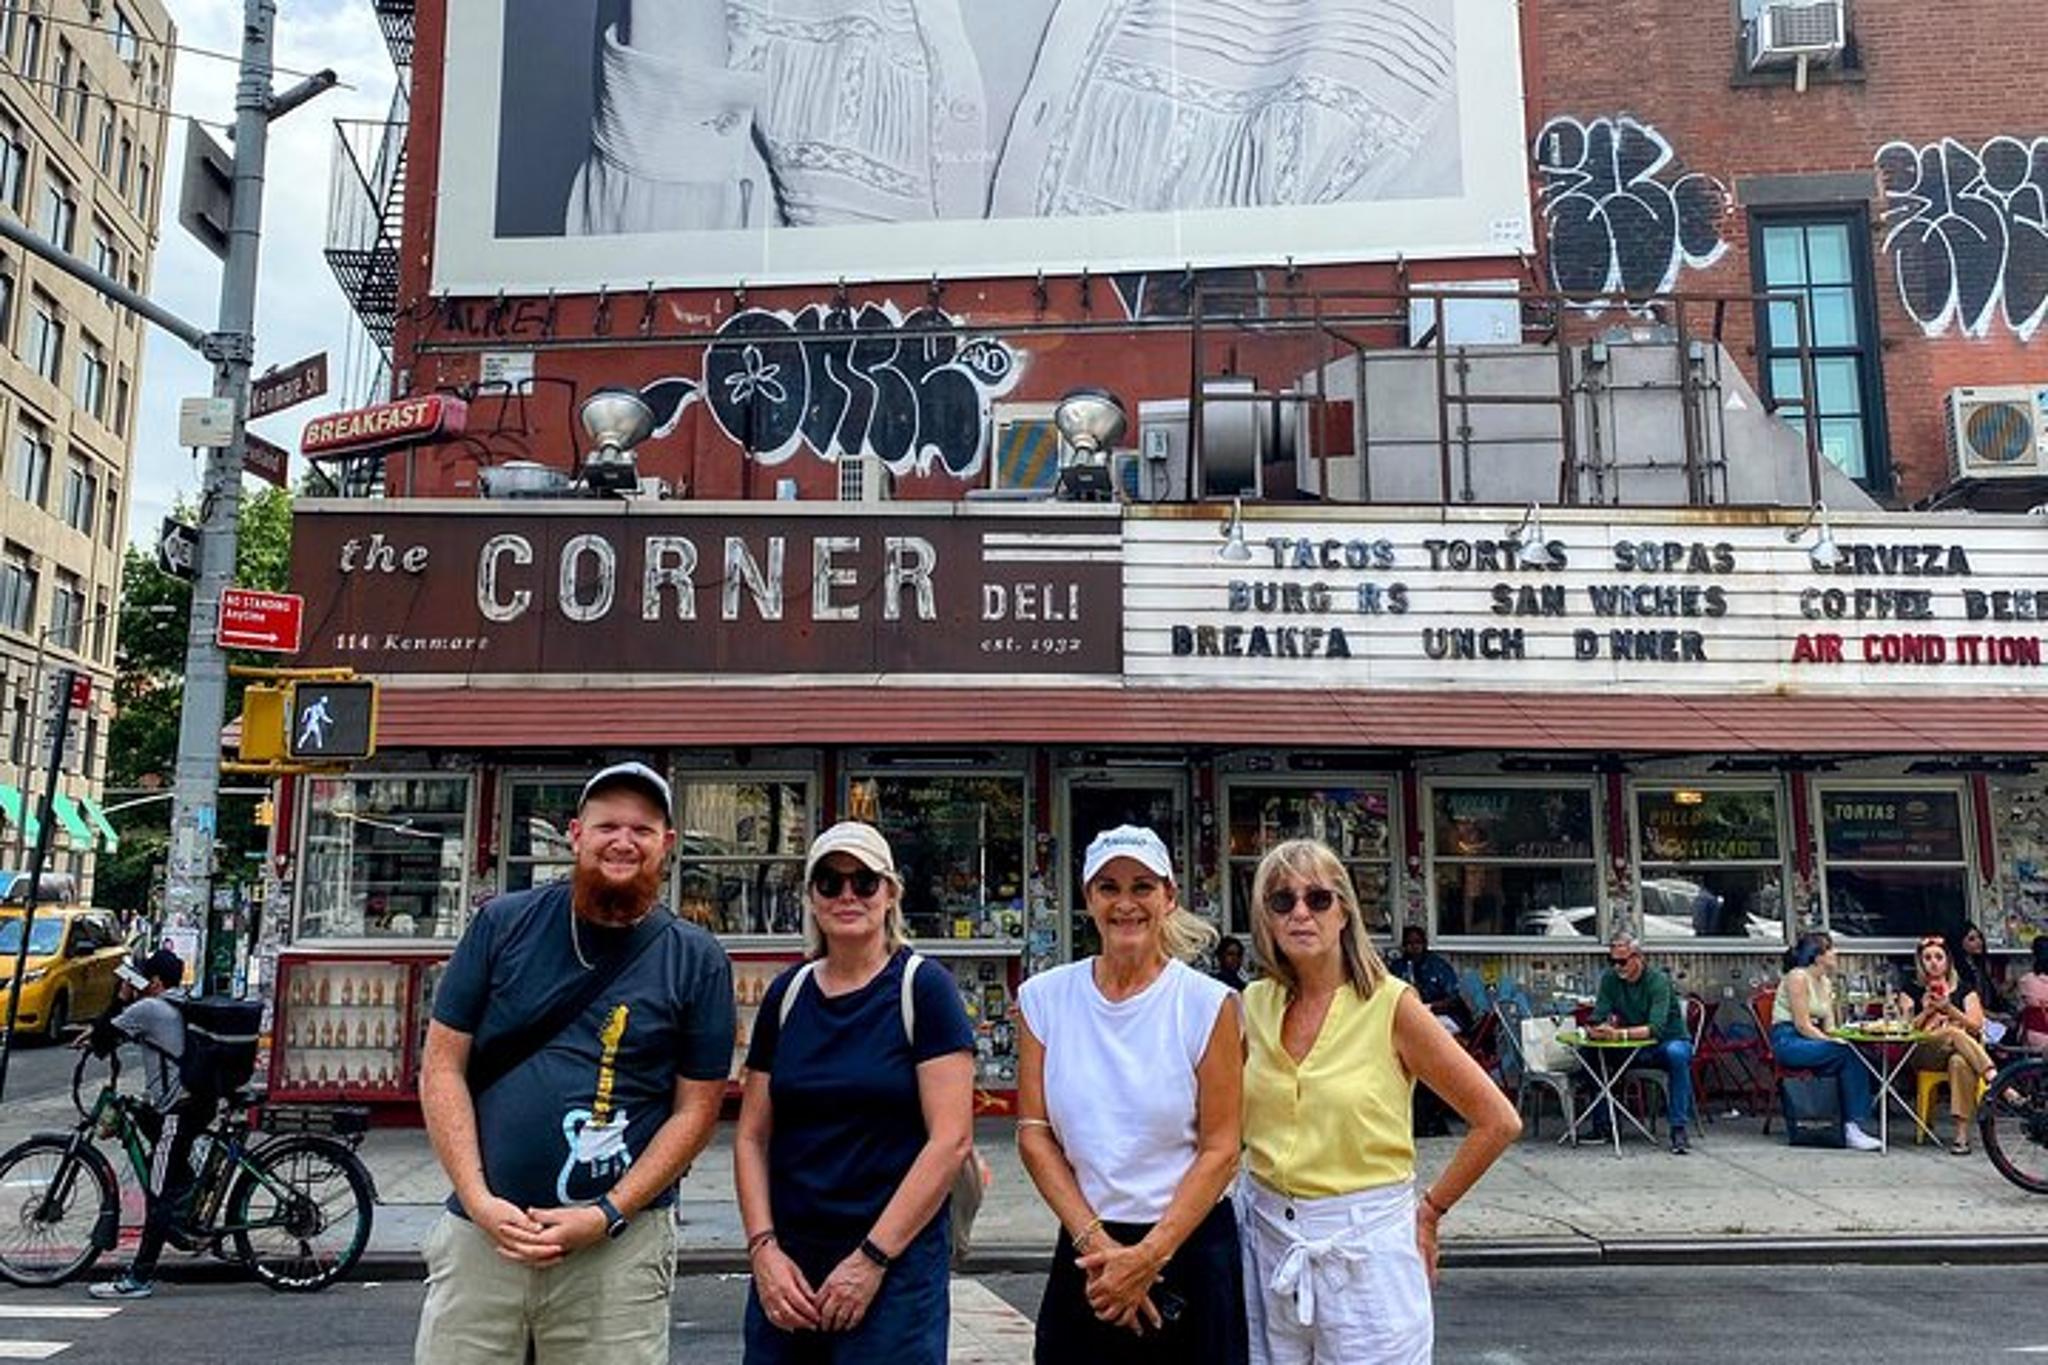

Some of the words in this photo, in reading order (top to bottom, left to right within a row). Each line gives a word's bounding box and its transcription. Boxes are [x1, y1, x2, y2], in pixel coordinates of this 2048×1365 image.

[306, 402, 429, 445] BREAKFAST
[1265, 537, 1395, 569] TACOS
[1614, 540, 1736, 573] SOPAS
[340, 533, 430, 574] the
[476, 532, 938, 622] CORNER
[983, 583, 1080, 620] DELI
[1799, 586, 1934, 620] COFFEE
[336, 634, 371, 650] 114
[383, 633, 489, 650] Kenmare
[980, 637, 1022, 652] est.
[1171, 625, 1352, 658] BREAKFA
[1791, 633, 1845, 664] AIR
[1834, 803, 1897, 821] TORTAS
